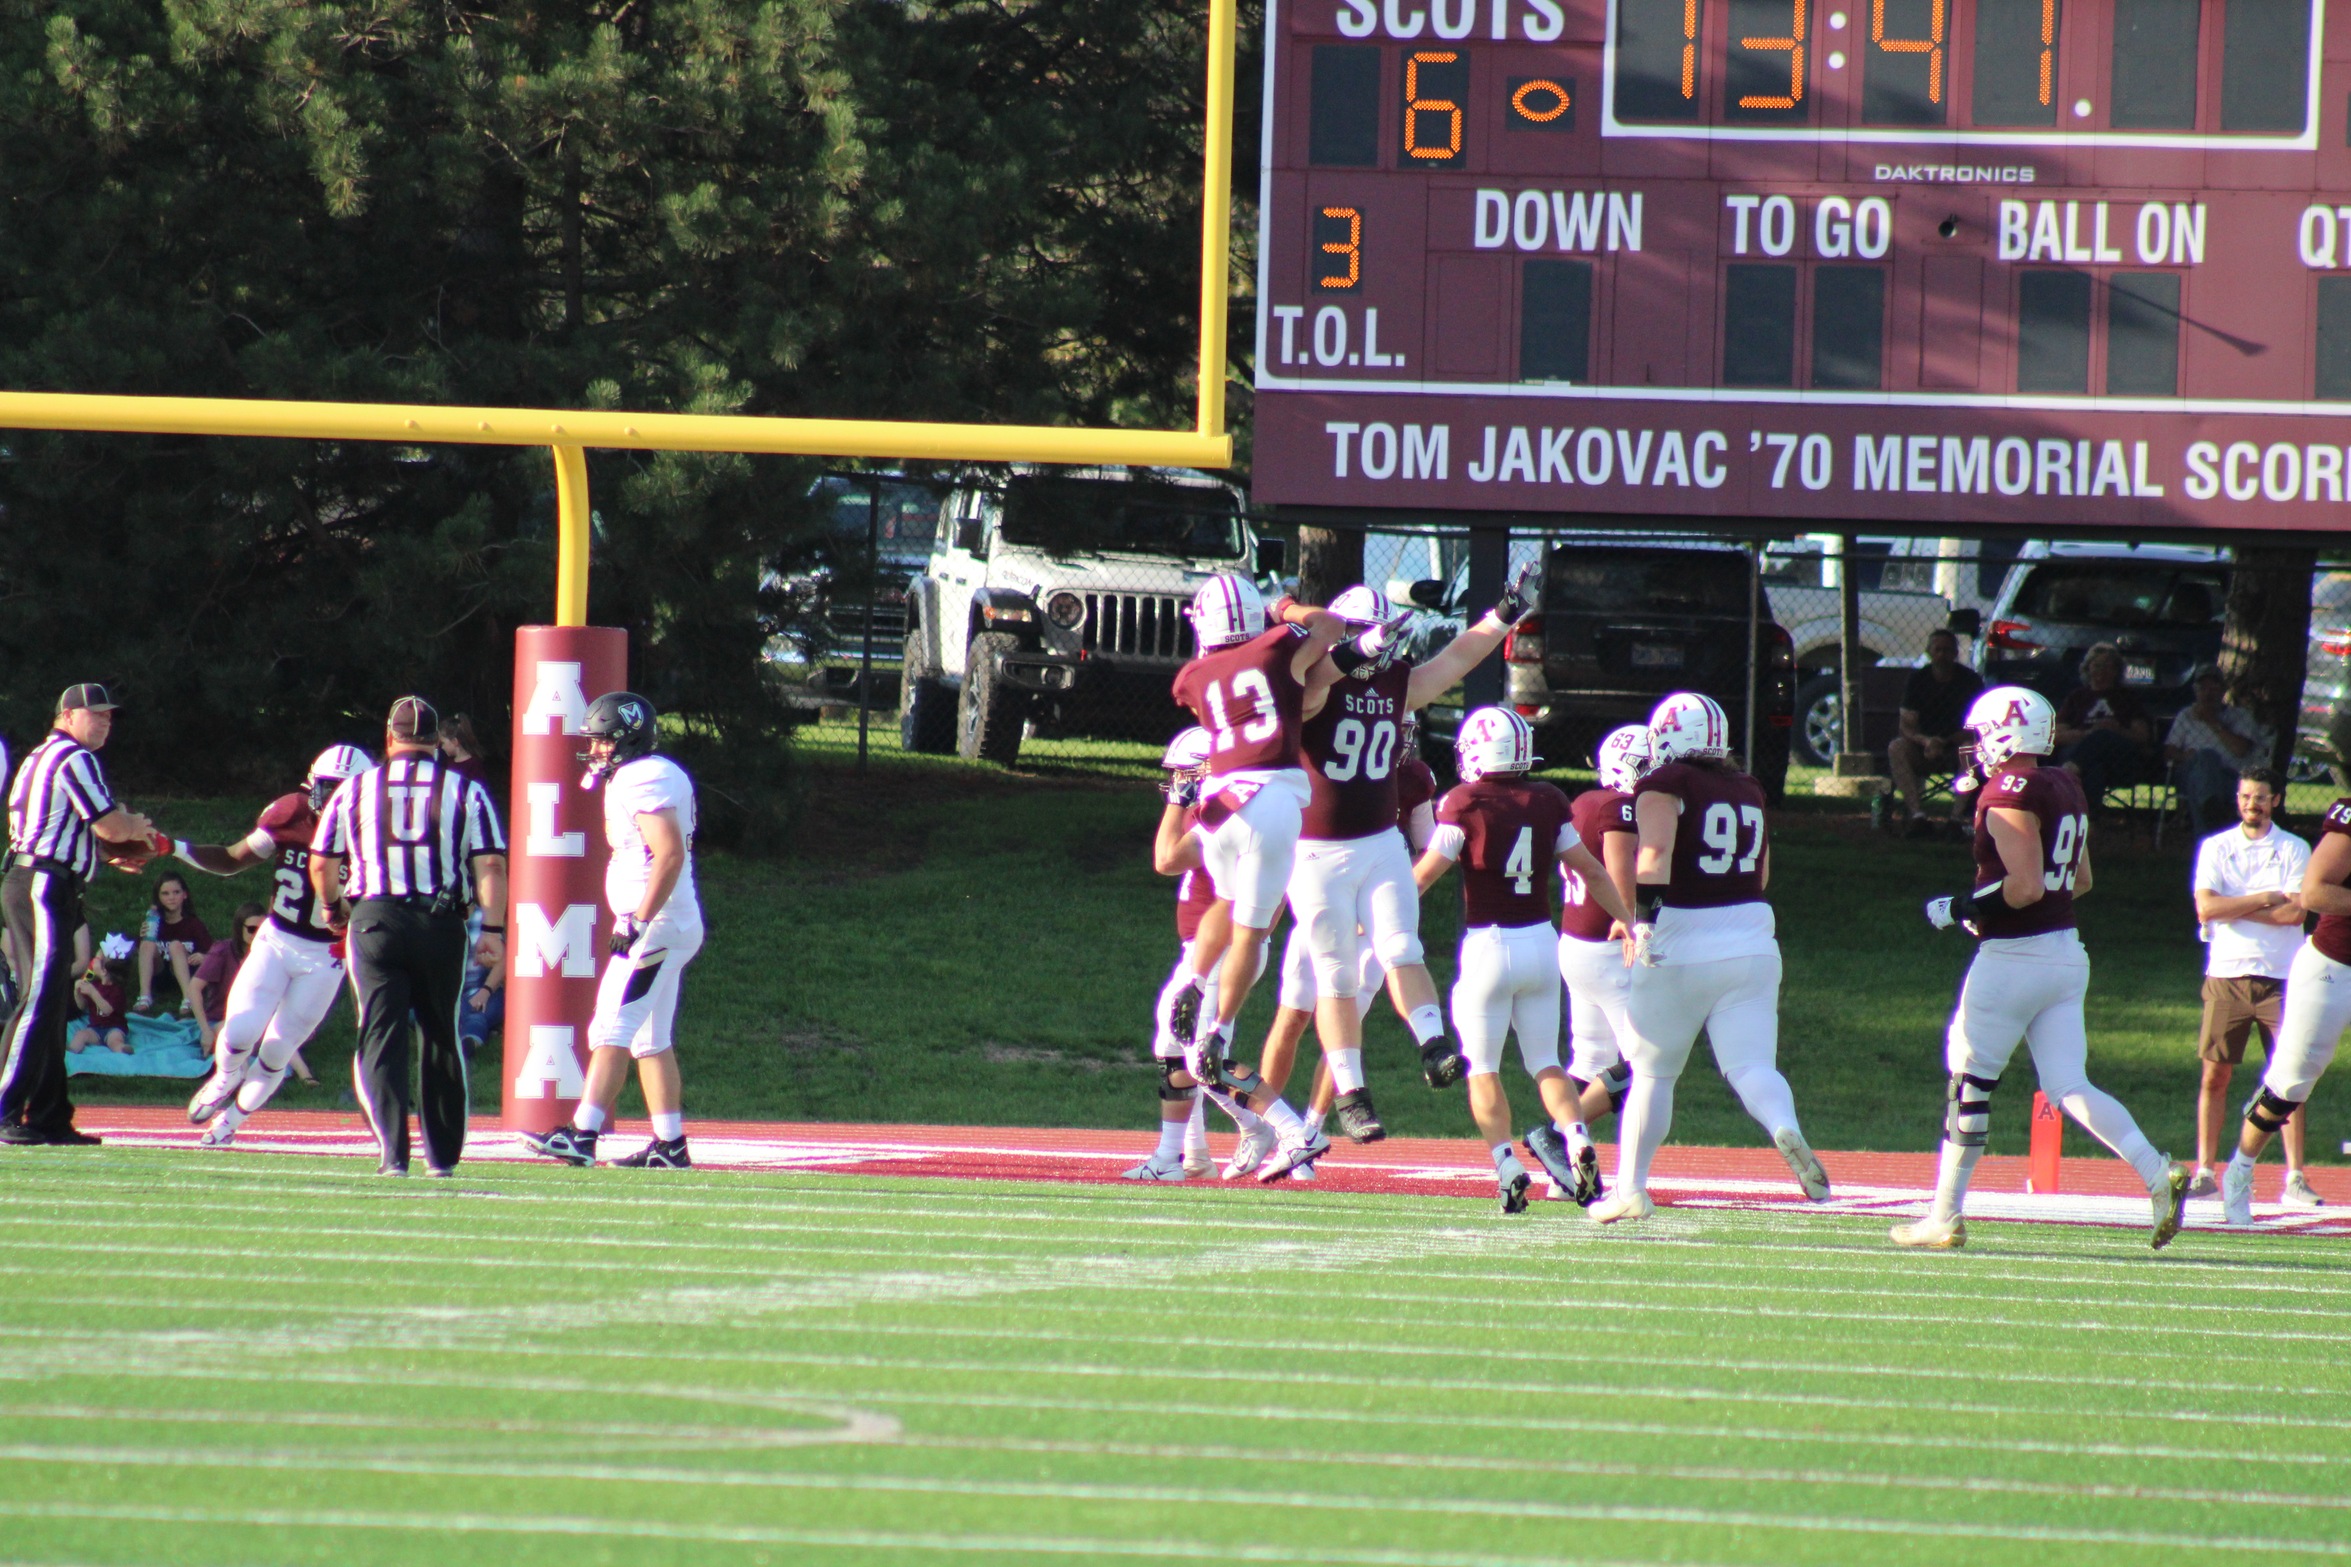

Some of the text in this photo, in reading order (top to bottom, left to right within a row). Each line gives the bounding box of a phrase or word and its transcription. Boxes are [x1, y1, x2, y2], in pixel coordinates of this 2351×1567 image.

[1336, 0, 1564, 41] SCOTS
[1404, 51, 1462, 159] 6
[1875, 164, 2036, 183] DAKTRONICS
[1320, 207, 1361, 289] 3
[1474, 189, 1643, 252] DOWN
[1726, 195, 1892, 259] TO GO
[1998, 200, 2207, 265] BALL ON
[1273, 305, 1406, 368] T.O.L.
[1325, 422, 1449, 480] TOM
[1468, 426, 1728, 489] JAKOVAC
[1853, 435, 2164, 498] MEMORIAL
[2184, 441, 2351, 502] SCOR
[1225, 633, 1250, 643] SCOTS
[1206, 669, 1278, 753] 13
[1346, 694, 1394, 715] SCOTS
[1660, 706, 1682, 733] A
[2003, 700, 2029, 726] A
[1324, 718, 1396, 782] 90
[1611, 732, 1636, 750] 63
[387, 785, 432, 841] U
[2001, 774, 2028, 793] 93
[284, 849, 348, 880] SCS
[1504, 826, 1534, 894] 4
[1699, 803, 1764, 874] 97
[514, 661, 597, 1099] ALMA
